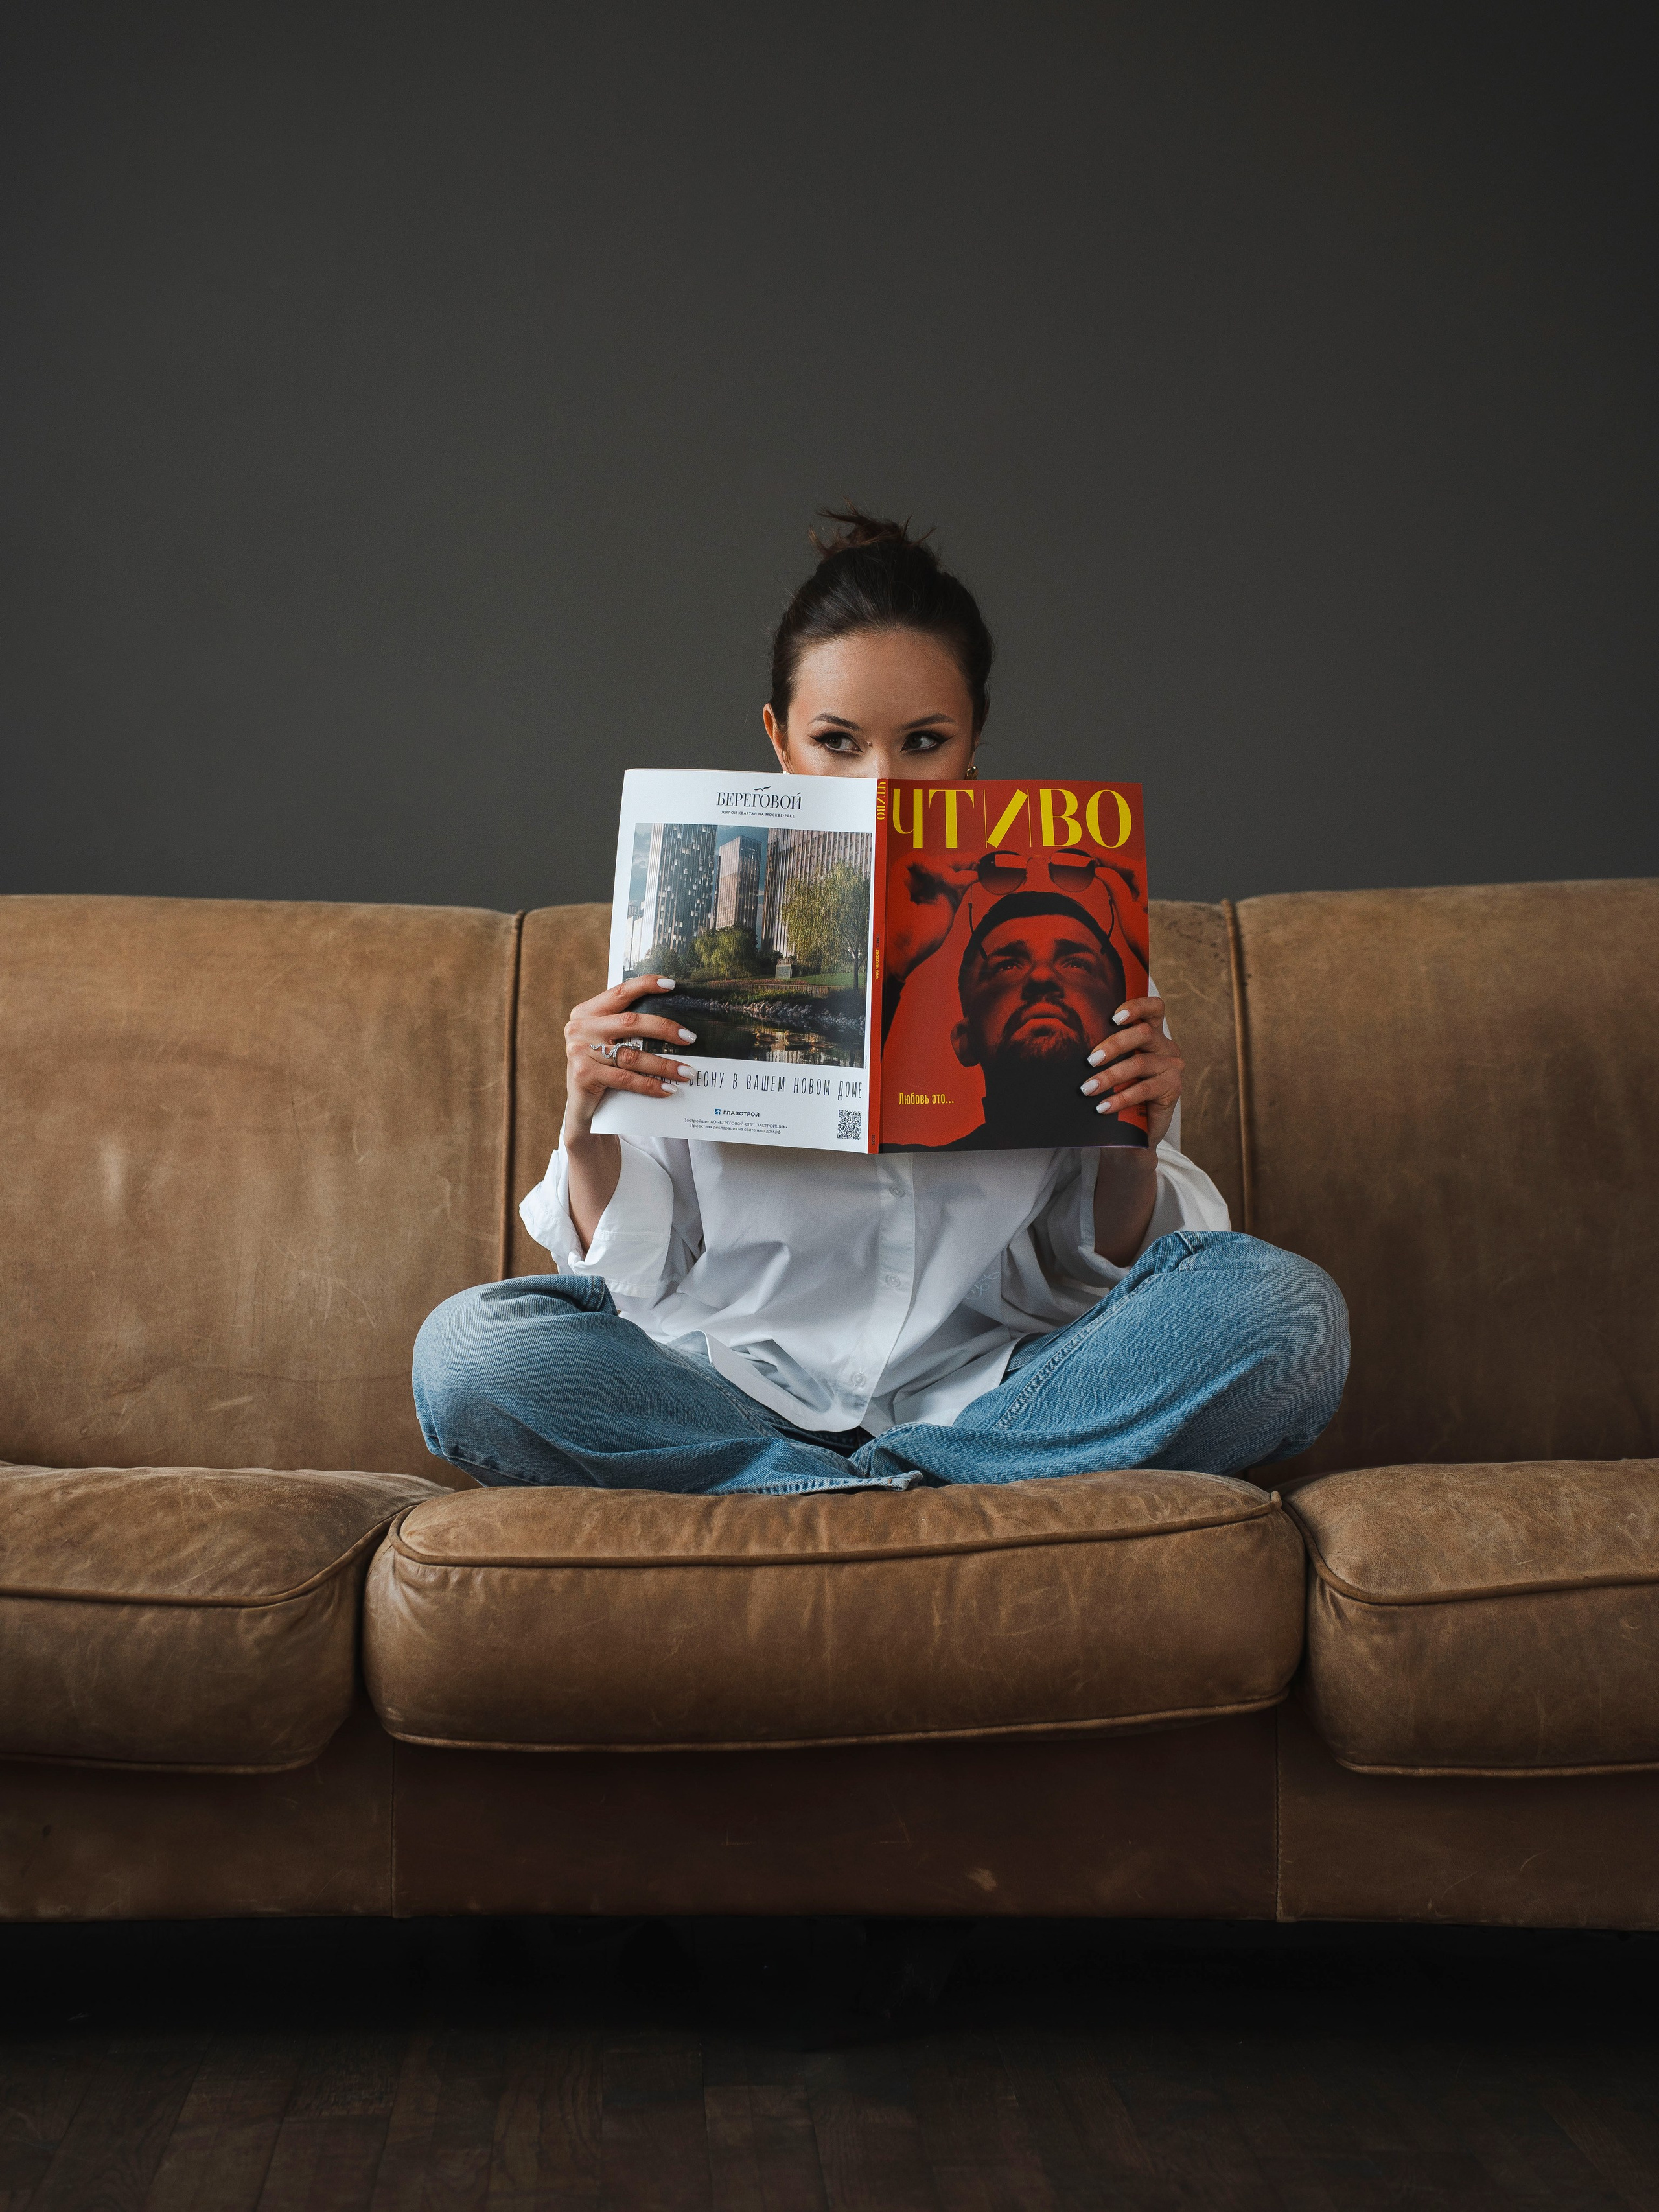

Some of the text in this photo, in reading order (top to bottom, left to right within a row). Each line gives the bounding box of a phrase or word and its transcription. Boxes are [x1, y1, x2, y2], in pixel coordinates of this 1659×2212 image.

[716, 791, 803, 810] БЕРЕГОВОЙ
[877, 781, 886, 821] ЧТИВО
[892, 787, 1132, 849] ЧТИВО
[732, 1073, 738, 1089] В
[746, 1074, 785, 1093] ВАШЕМ
[793, 1077, 831, 1096] НОВОМ
[837, 1080, 863, 1101] ДОМЕ
[898, 1092, 929, 1105] Любовь
